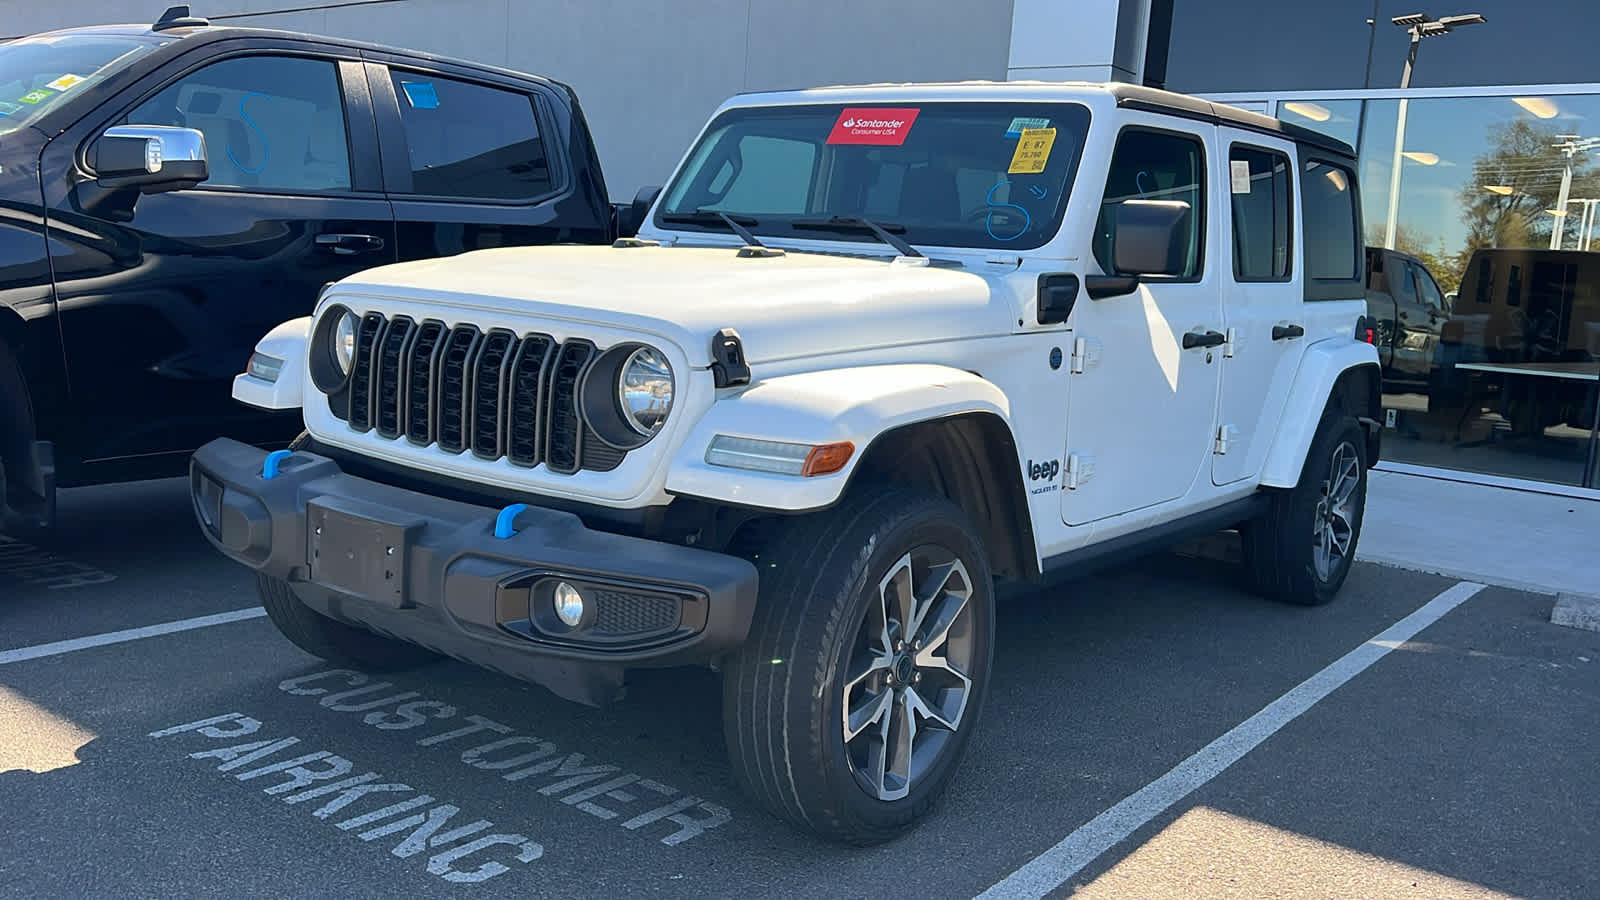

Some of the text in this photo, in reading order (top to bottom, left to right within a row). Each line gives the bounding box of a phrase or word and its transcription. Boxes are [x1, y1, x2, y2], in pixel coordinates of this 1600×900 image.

[855, 119, 904, 128] Santander
[1027, 459, 1059, 481] Jeep
[148, 711, 544, 884] PARKING
[278, 668, 733, 848] CUSTOMER
